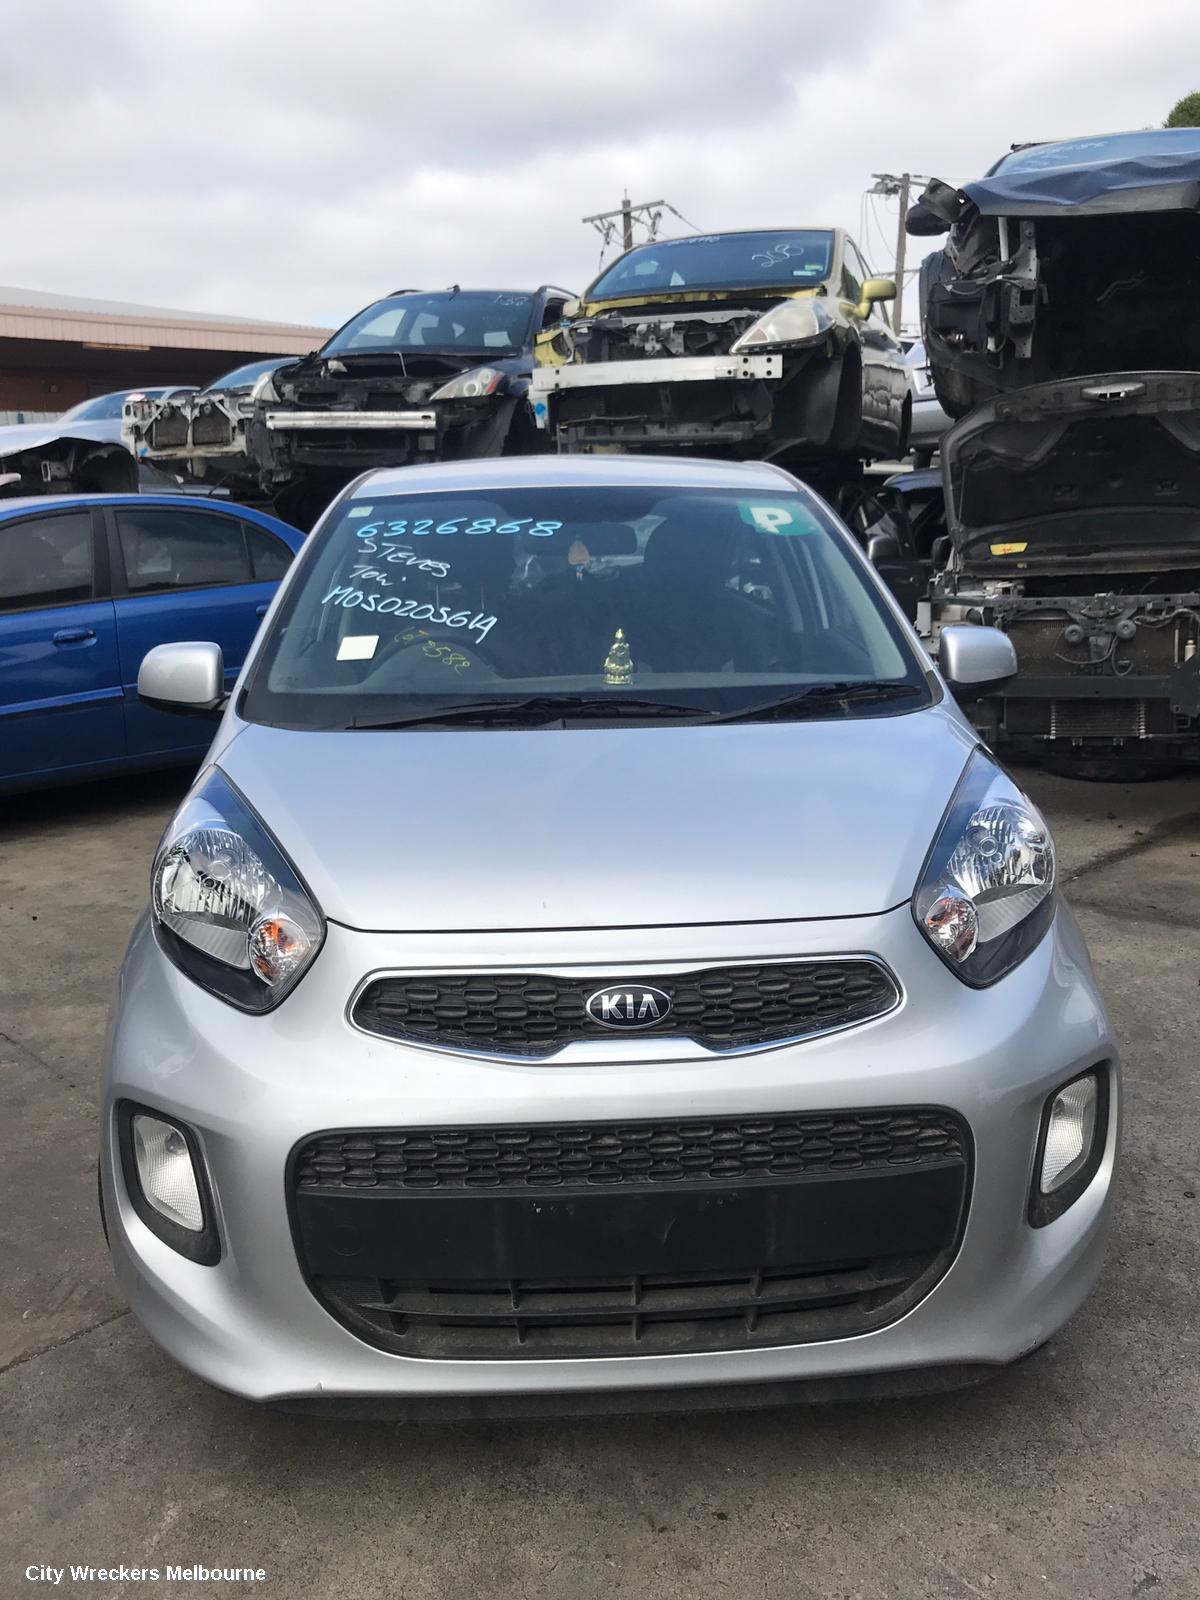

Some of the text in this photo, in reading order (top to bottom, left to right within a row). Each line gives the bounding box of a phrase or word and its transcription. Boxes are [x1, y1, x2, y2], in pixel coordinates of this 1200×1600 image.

[356, 517, 563, 538] 6326868
[751, 507, 793, 534] P
[600, 993, 661, 1019] KIA
